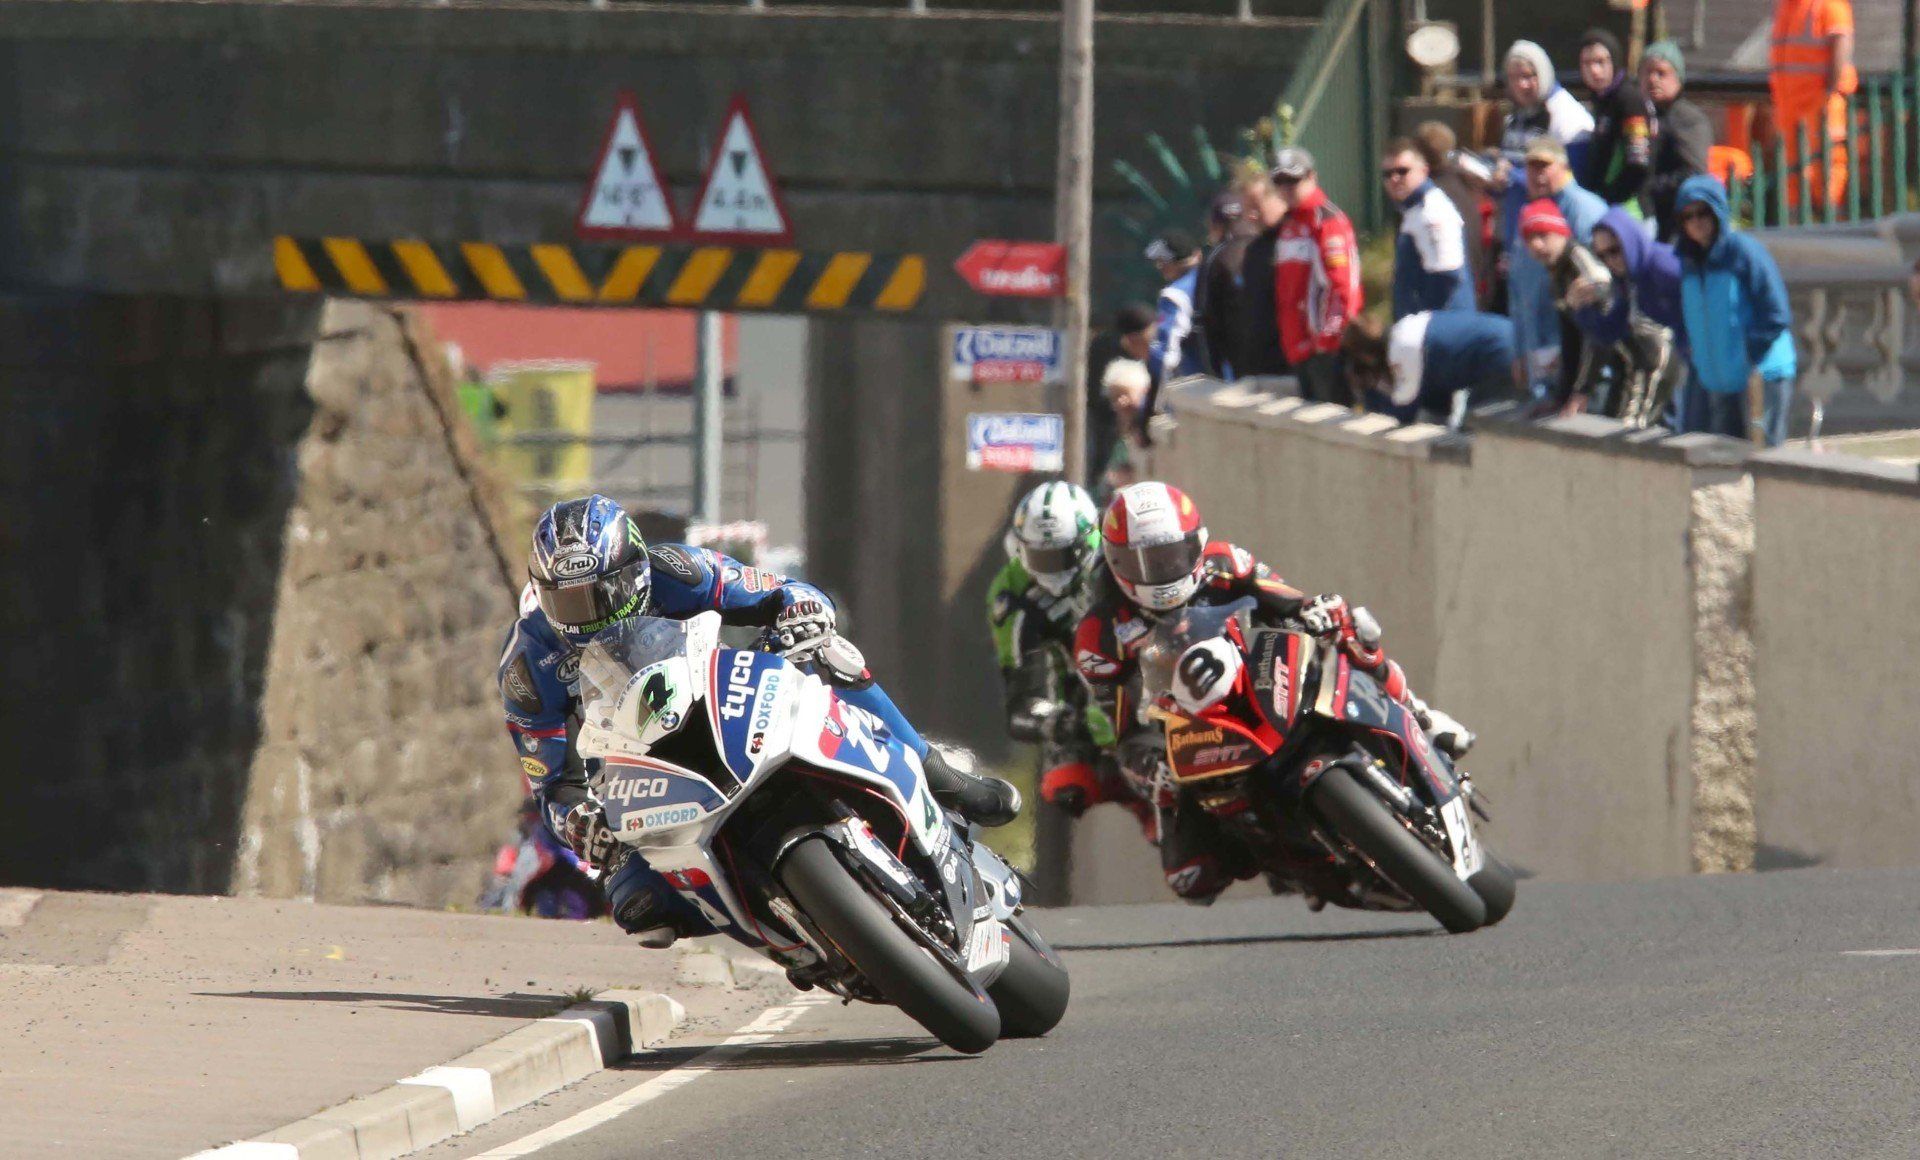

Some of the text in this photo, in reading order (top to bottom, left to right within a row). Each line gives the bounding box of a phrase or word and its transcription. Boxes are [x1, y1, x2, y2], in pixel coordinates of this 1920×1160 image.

[557, 556, 591, 573] Arai
[581, 618, 608, 634] TRUCK
[608, 615, 616, 624] &
[615, 594, 639, 618] TRAILER
[637, 668, 676, 737] 4
[720, 650, 755, 721] tyco
[755, 674, 780, 731] OXFORD
[607, 773, 669, 807] tyco
[645, 808, 698, 828] OXFORD
